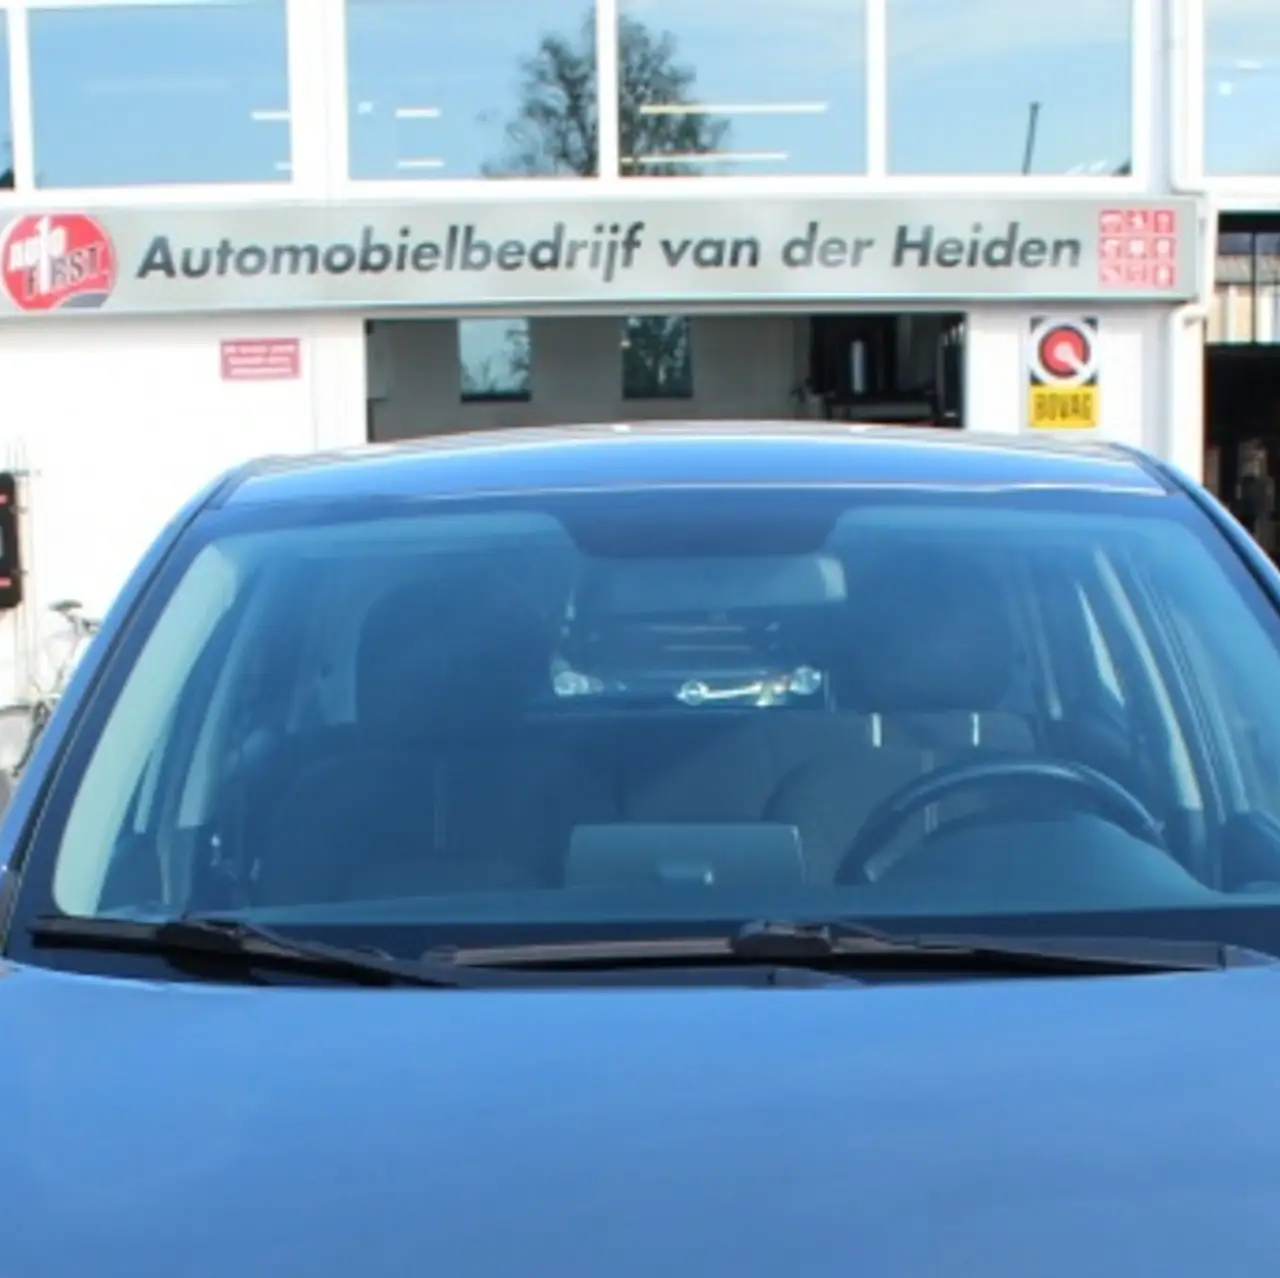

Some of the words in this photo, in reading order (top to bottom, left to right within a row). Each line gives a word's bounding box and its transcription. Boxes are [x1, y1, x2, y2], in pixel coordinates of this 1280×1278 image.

[136, 222, 646, 284] Automobielbedrijf
[662, 233, 760, 269] van
[781, 222, 875, 269] der
[892, 223, 1082, 269] Heiden
